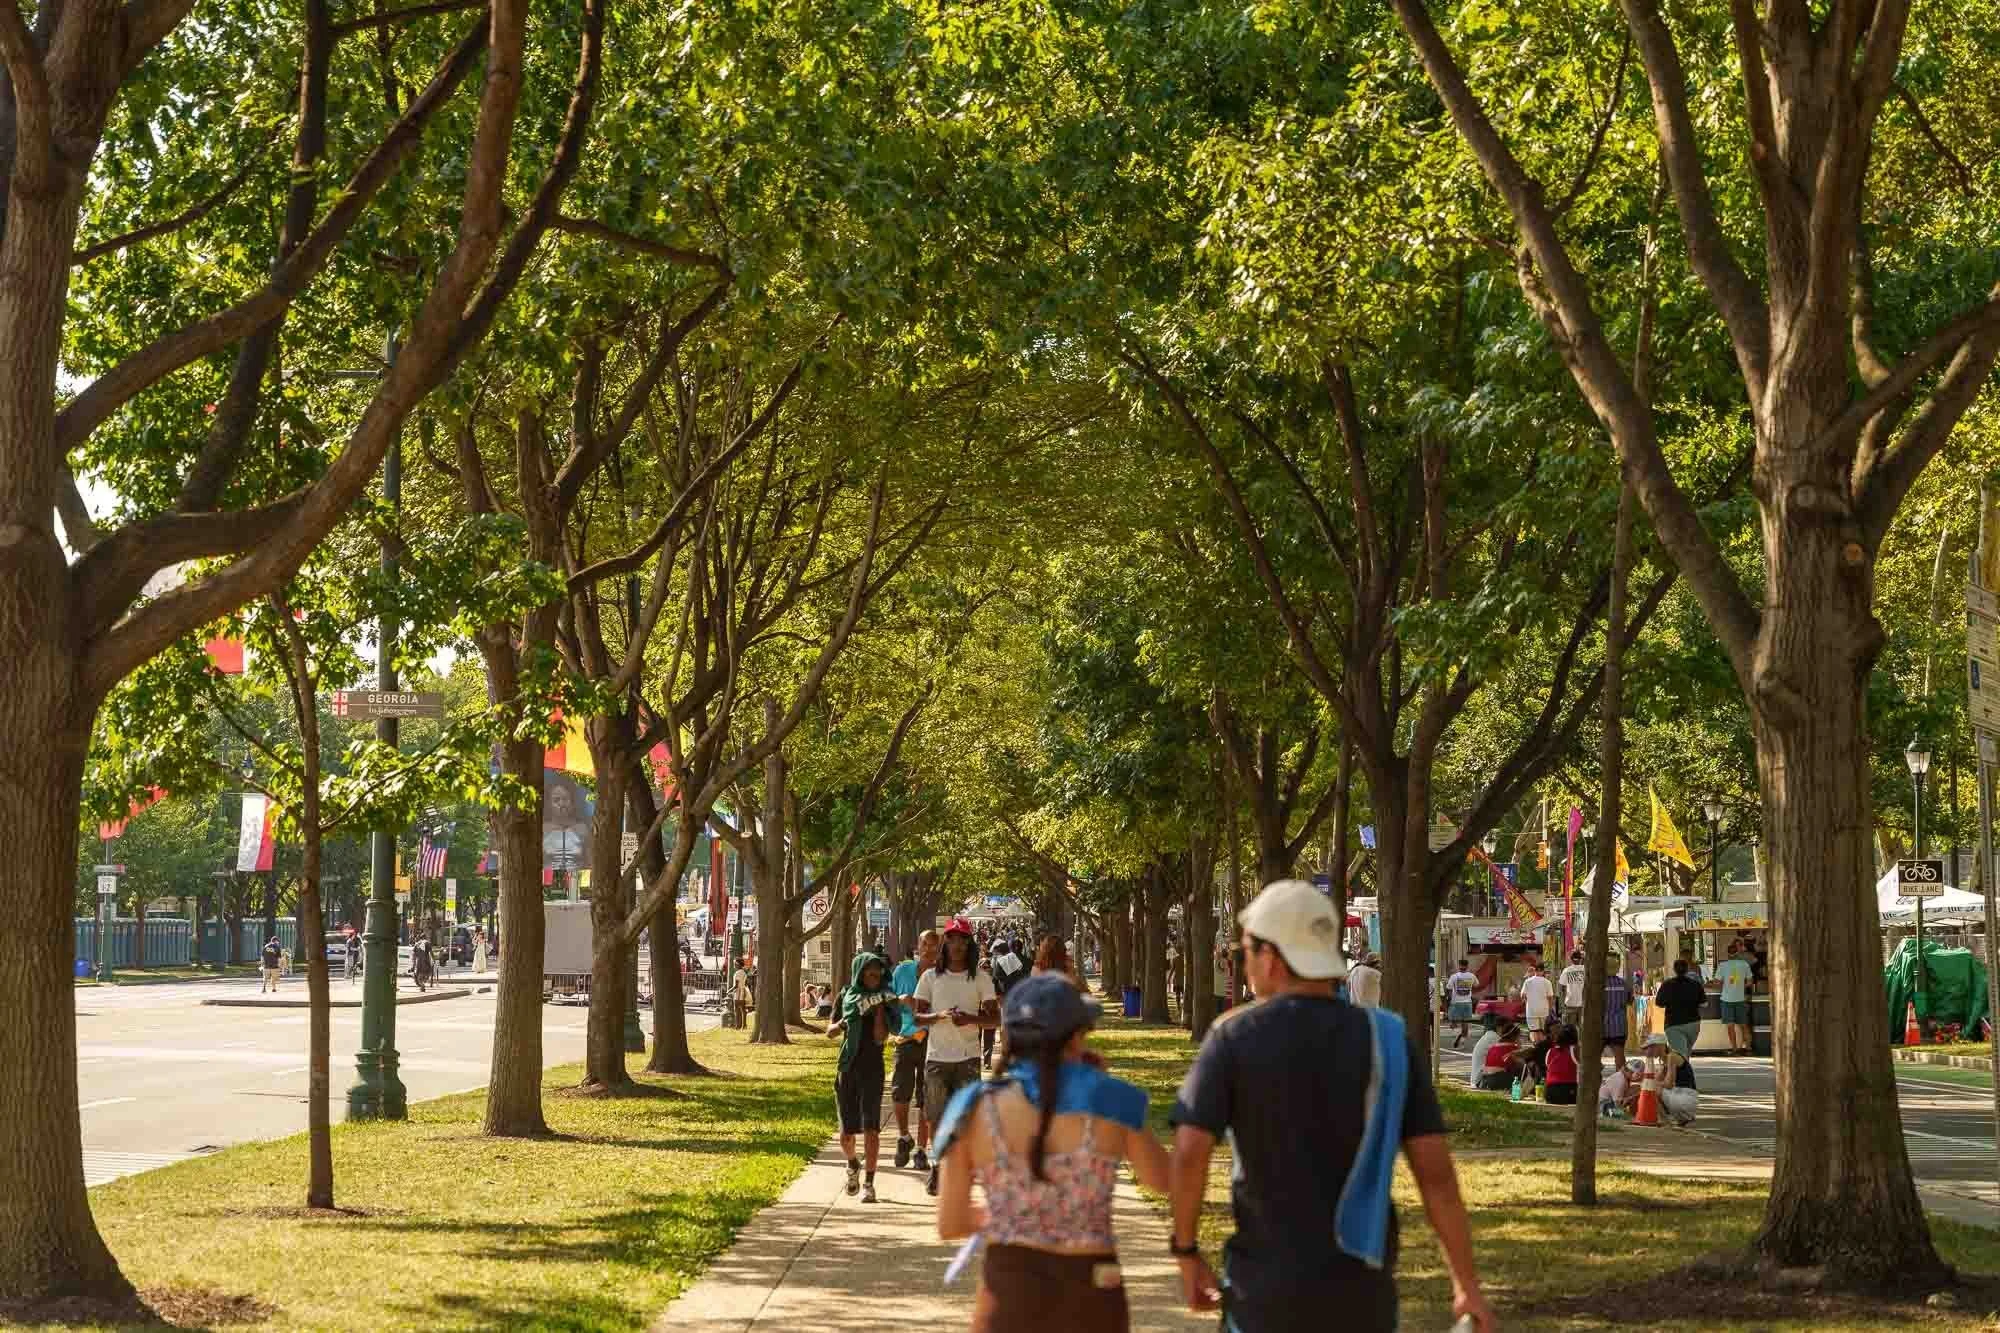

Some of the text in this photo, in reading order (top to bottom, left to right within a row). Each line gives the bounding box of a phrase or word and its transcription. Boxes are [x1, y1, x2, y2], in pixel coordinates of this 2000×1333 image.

[367, 693, 419, 705] GEORGIA
[1903, 885, 1938, 893] BIKE LANE
